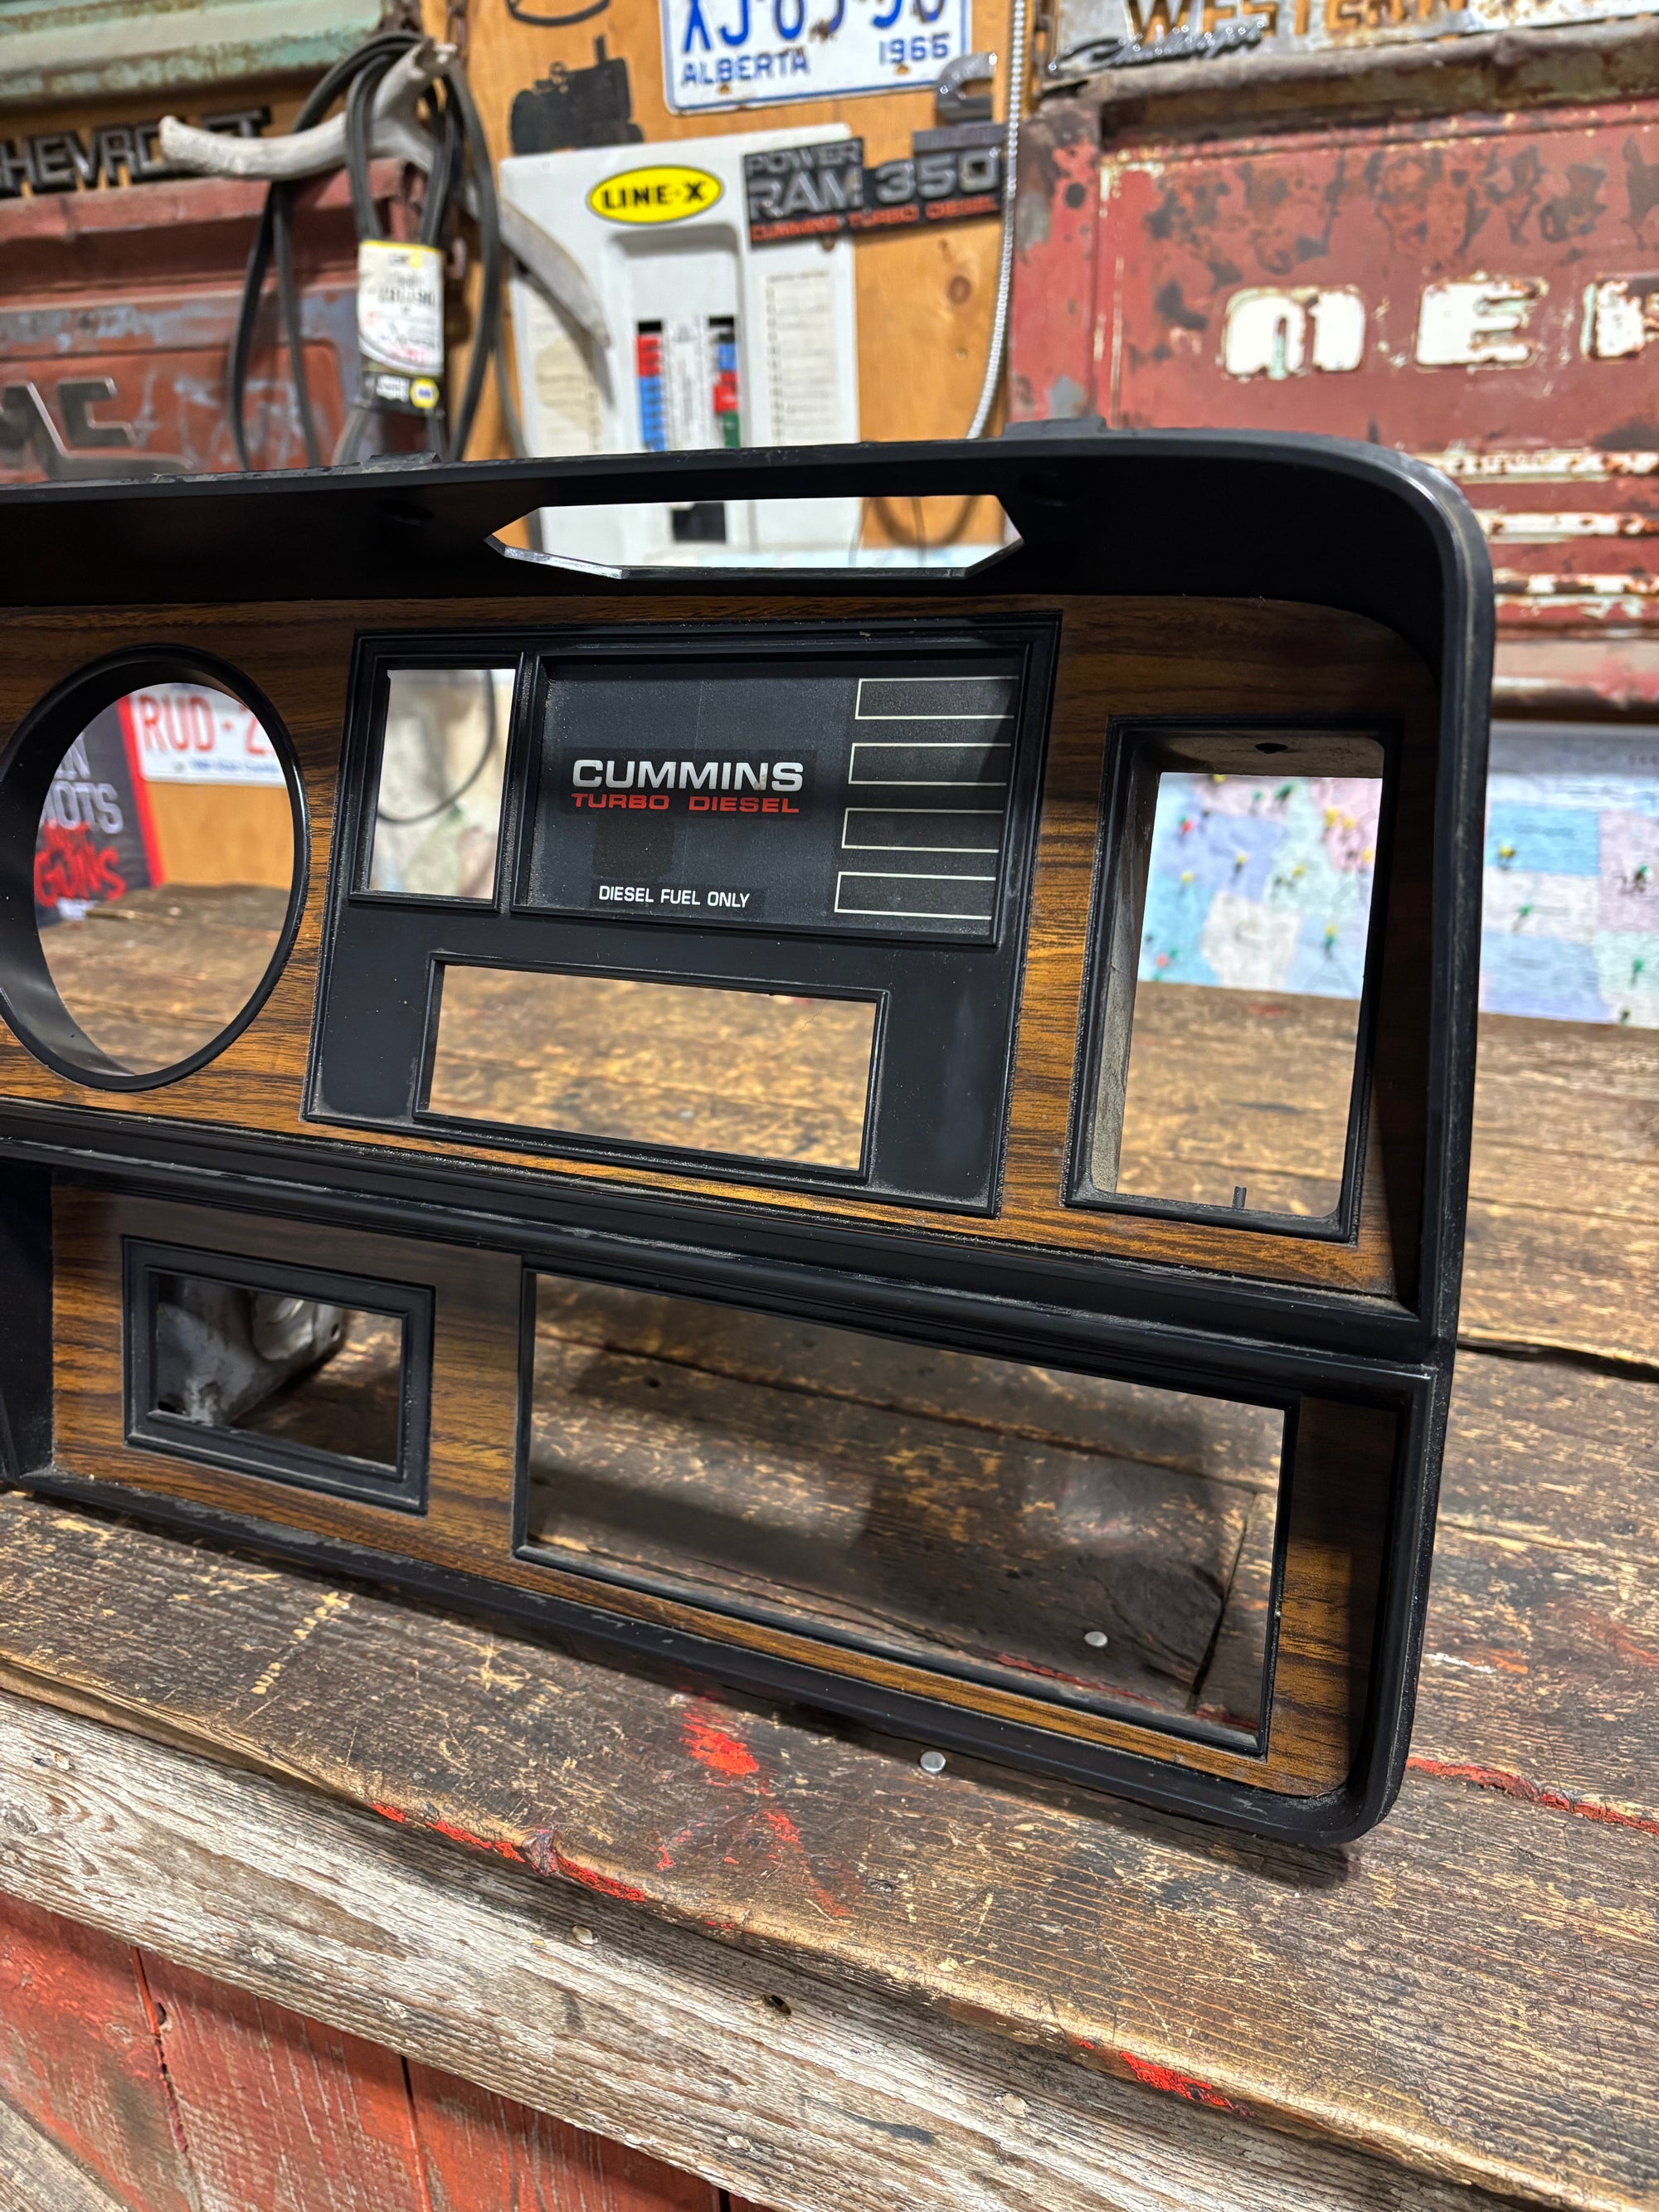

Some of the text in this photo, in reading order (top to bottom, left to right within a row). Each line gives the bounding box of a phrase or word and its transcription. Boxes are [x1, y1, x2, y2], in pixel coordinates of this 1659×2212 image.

[681, 46, 810, 84] ALBERTA
[748, 142, 861, 174] POWER
[601, 181, 706, 209] LINE-X
[748, 148, 999, 219] RAM 350
[846, 204, 919, 228] TURBO
[924, 195, 999, 220] DIESEL
[572, 759, 804, 792] CUMMINS
[571, 793, 800, 814] TURBO DIESEL
[598, 885, 751, 909] DIESEL FUEL ONLY
